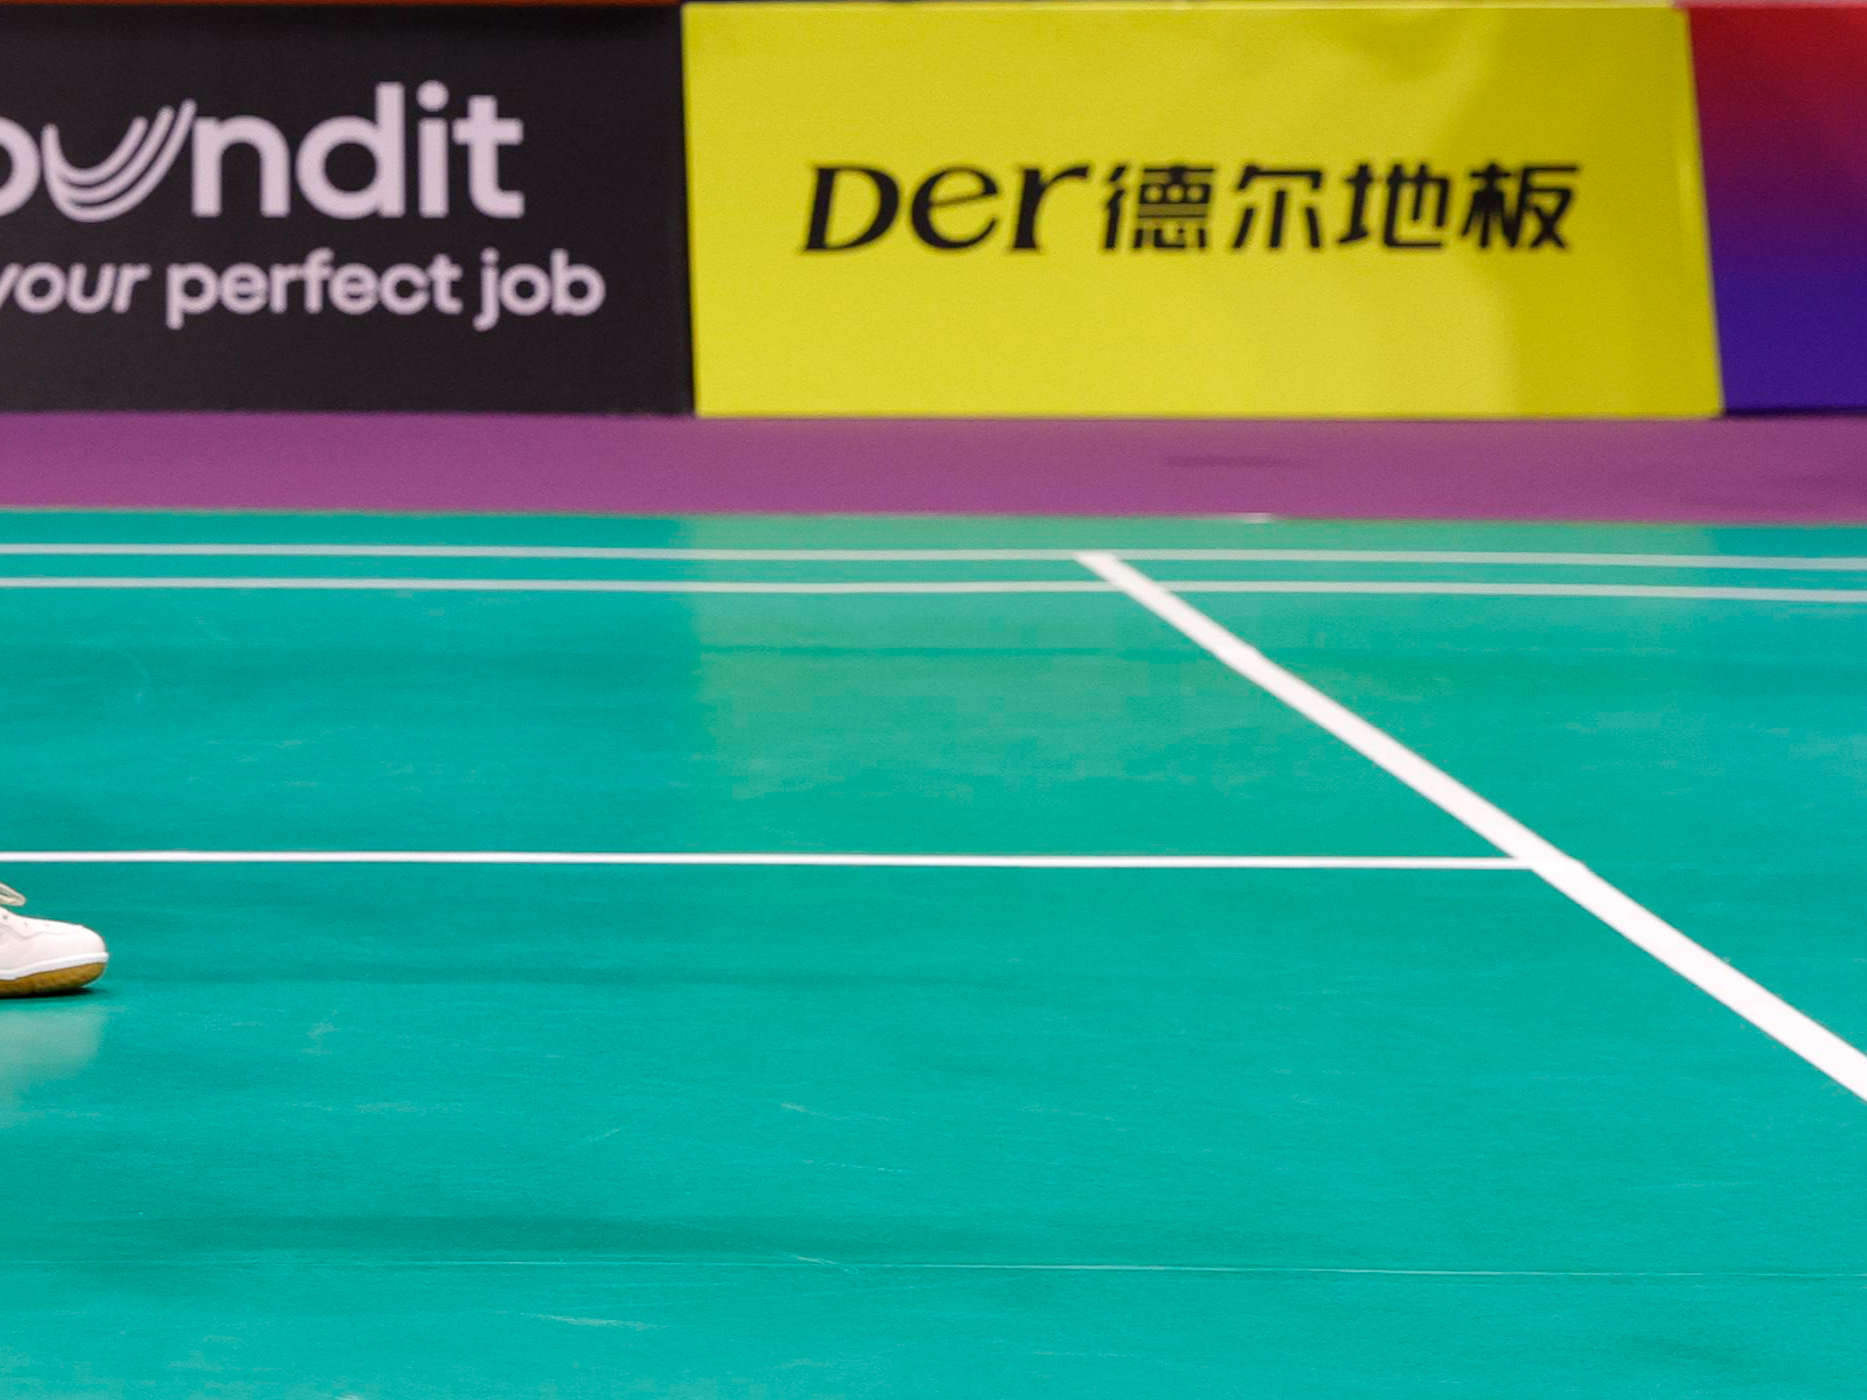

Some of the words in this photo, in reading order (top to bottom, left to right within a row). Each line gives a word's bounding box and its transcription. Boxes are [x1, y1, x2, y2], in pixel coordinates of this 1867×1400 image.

[1100, 159, 1582, 254] 德尔地板
[166, 248, 464, 330] perfect
[474, 248, 608, 331] job
